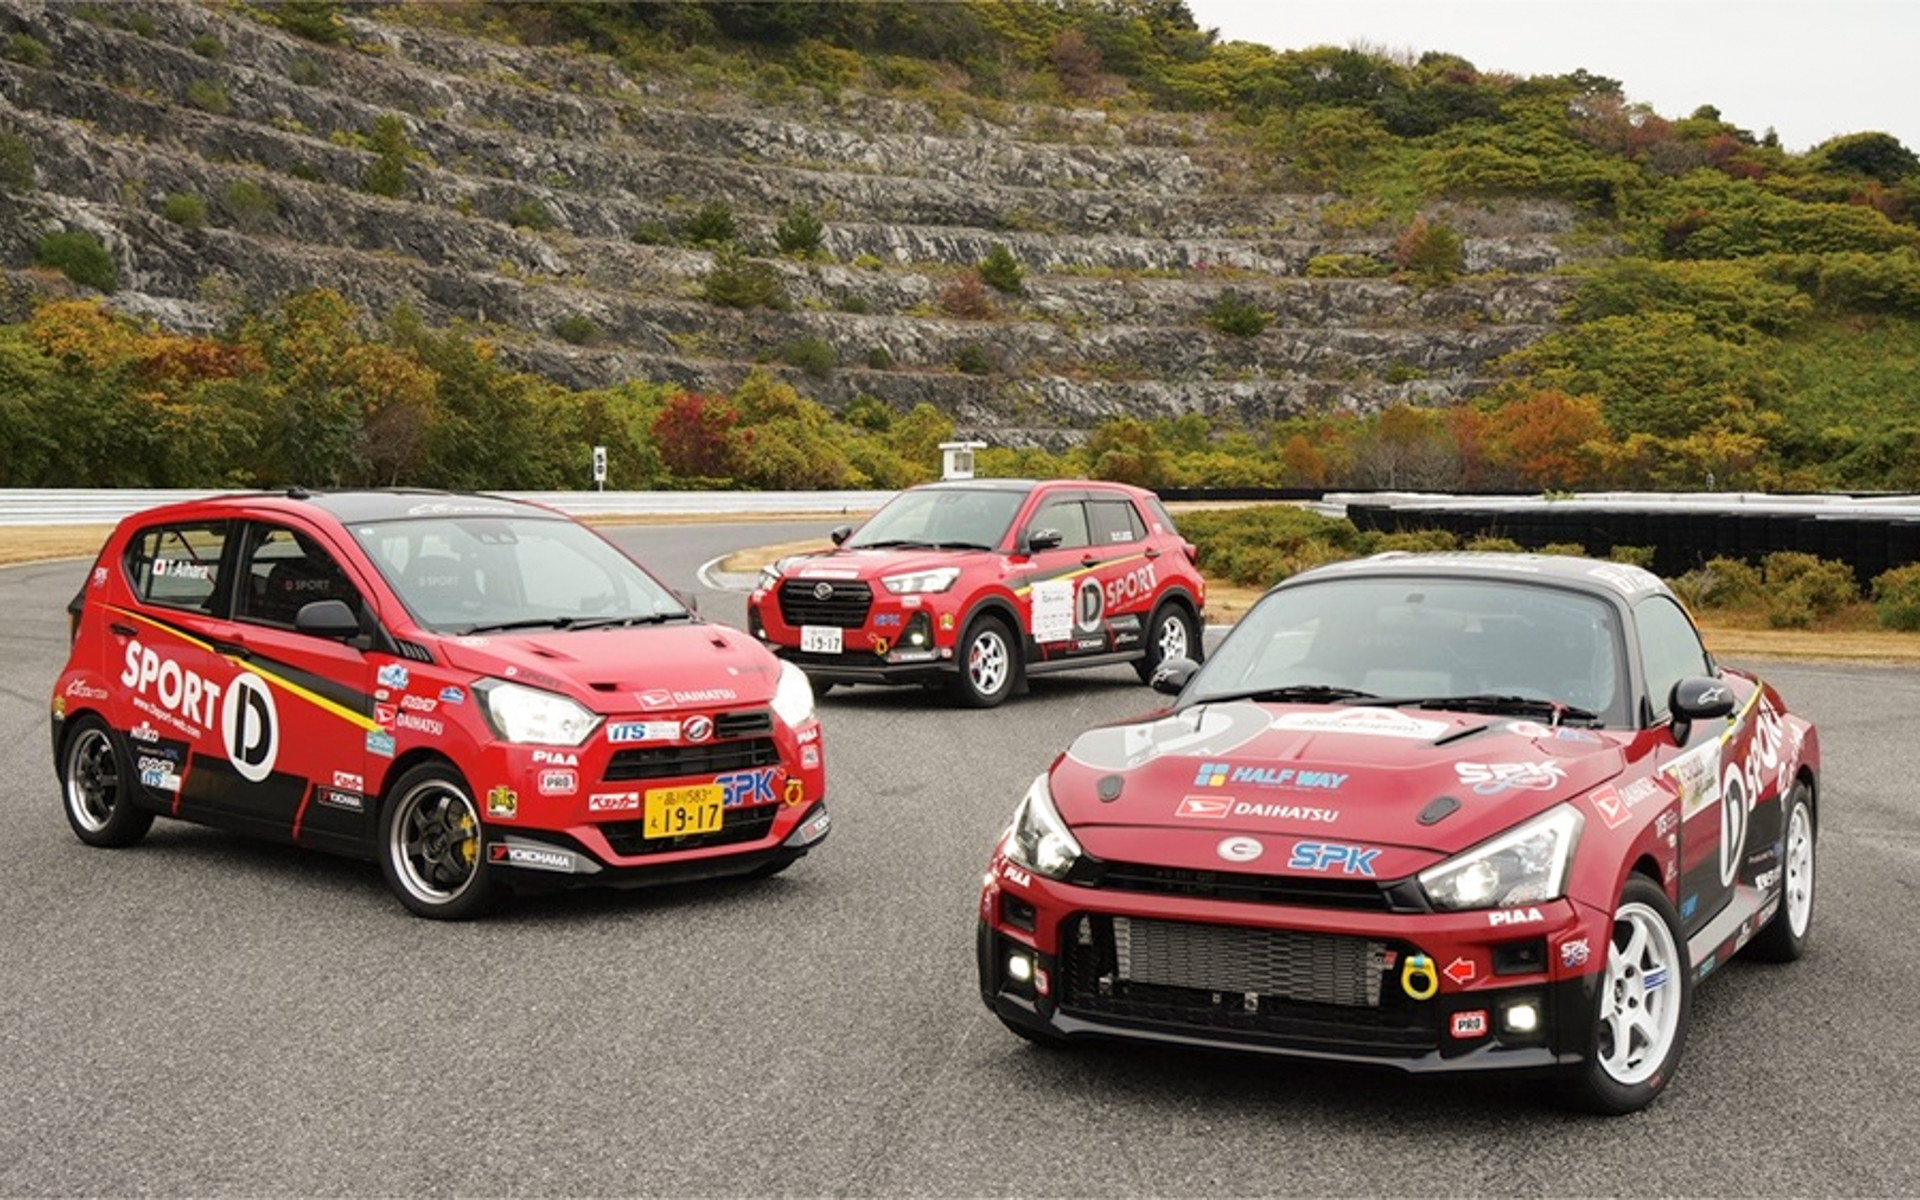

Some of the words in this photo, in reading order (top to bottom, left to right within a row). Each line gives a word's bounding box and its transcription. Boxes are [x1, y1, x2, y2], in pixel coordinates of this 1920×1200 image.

[296, 579, 330, 590] SPORT
[1106, 563, 1156, 608] SPORT
[810, 636, 841, 650] 19-17
[121, 640, 221, 730] SPORT
[673, 689, 737, 702] DAIHATSU
[612, 724, 647, 740] ITS
[532, 750, 579, 767] PIAA
[546, 776, 570, 788] PRO
[1230, 766, 1294, 784] HALF
[1296, 770, 1349, 789] WAY
[1454, 759, 1569, 785] SPK
[714, 769, 775, 807] SPK
[665, 803, 719, 834] 19-17
[1233, 801, 1340, 823] DAIHATSU
[509, 849, 570, 867] YOKOHAMA
[1287, 841, 1383, 876] SPK
[1003, 866, 1031, 888] PIAA
[1488, 907, 1544, 927] PIAA
[1457, 1017, 1482, 1031] PRO
